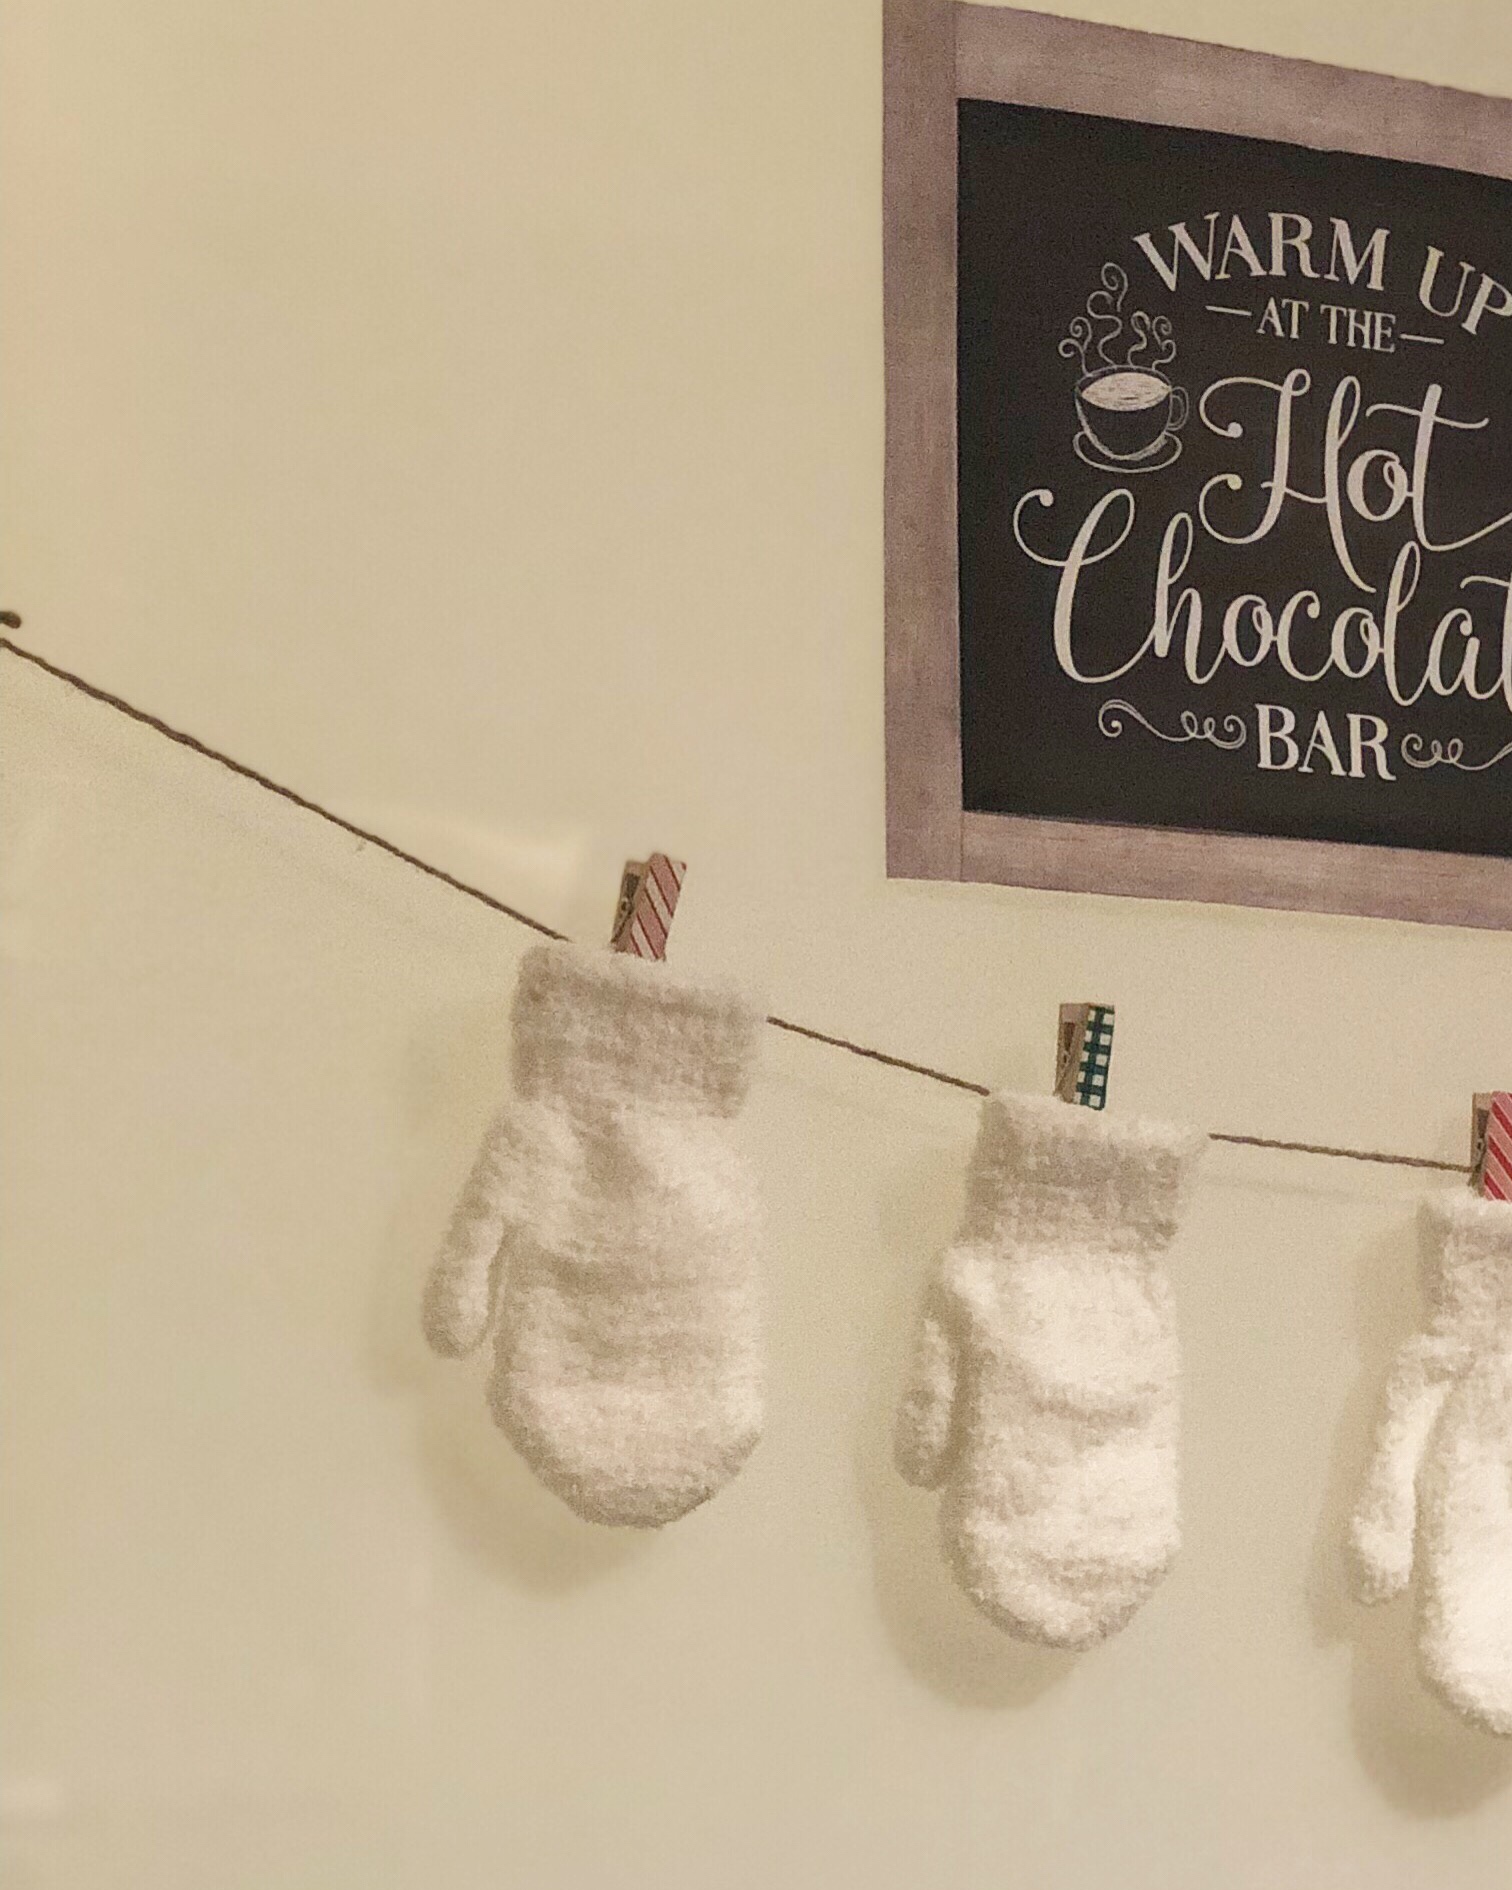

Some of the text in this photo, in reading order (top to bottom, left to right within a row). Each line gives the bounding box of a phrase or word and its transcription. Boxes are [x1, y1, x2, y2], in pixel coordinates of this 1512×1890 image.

[1134, 210, 1390, 292] WARM
[1257, 297, 1397, 353] AT THE
[1255, 703, 1397, 781] BAR
